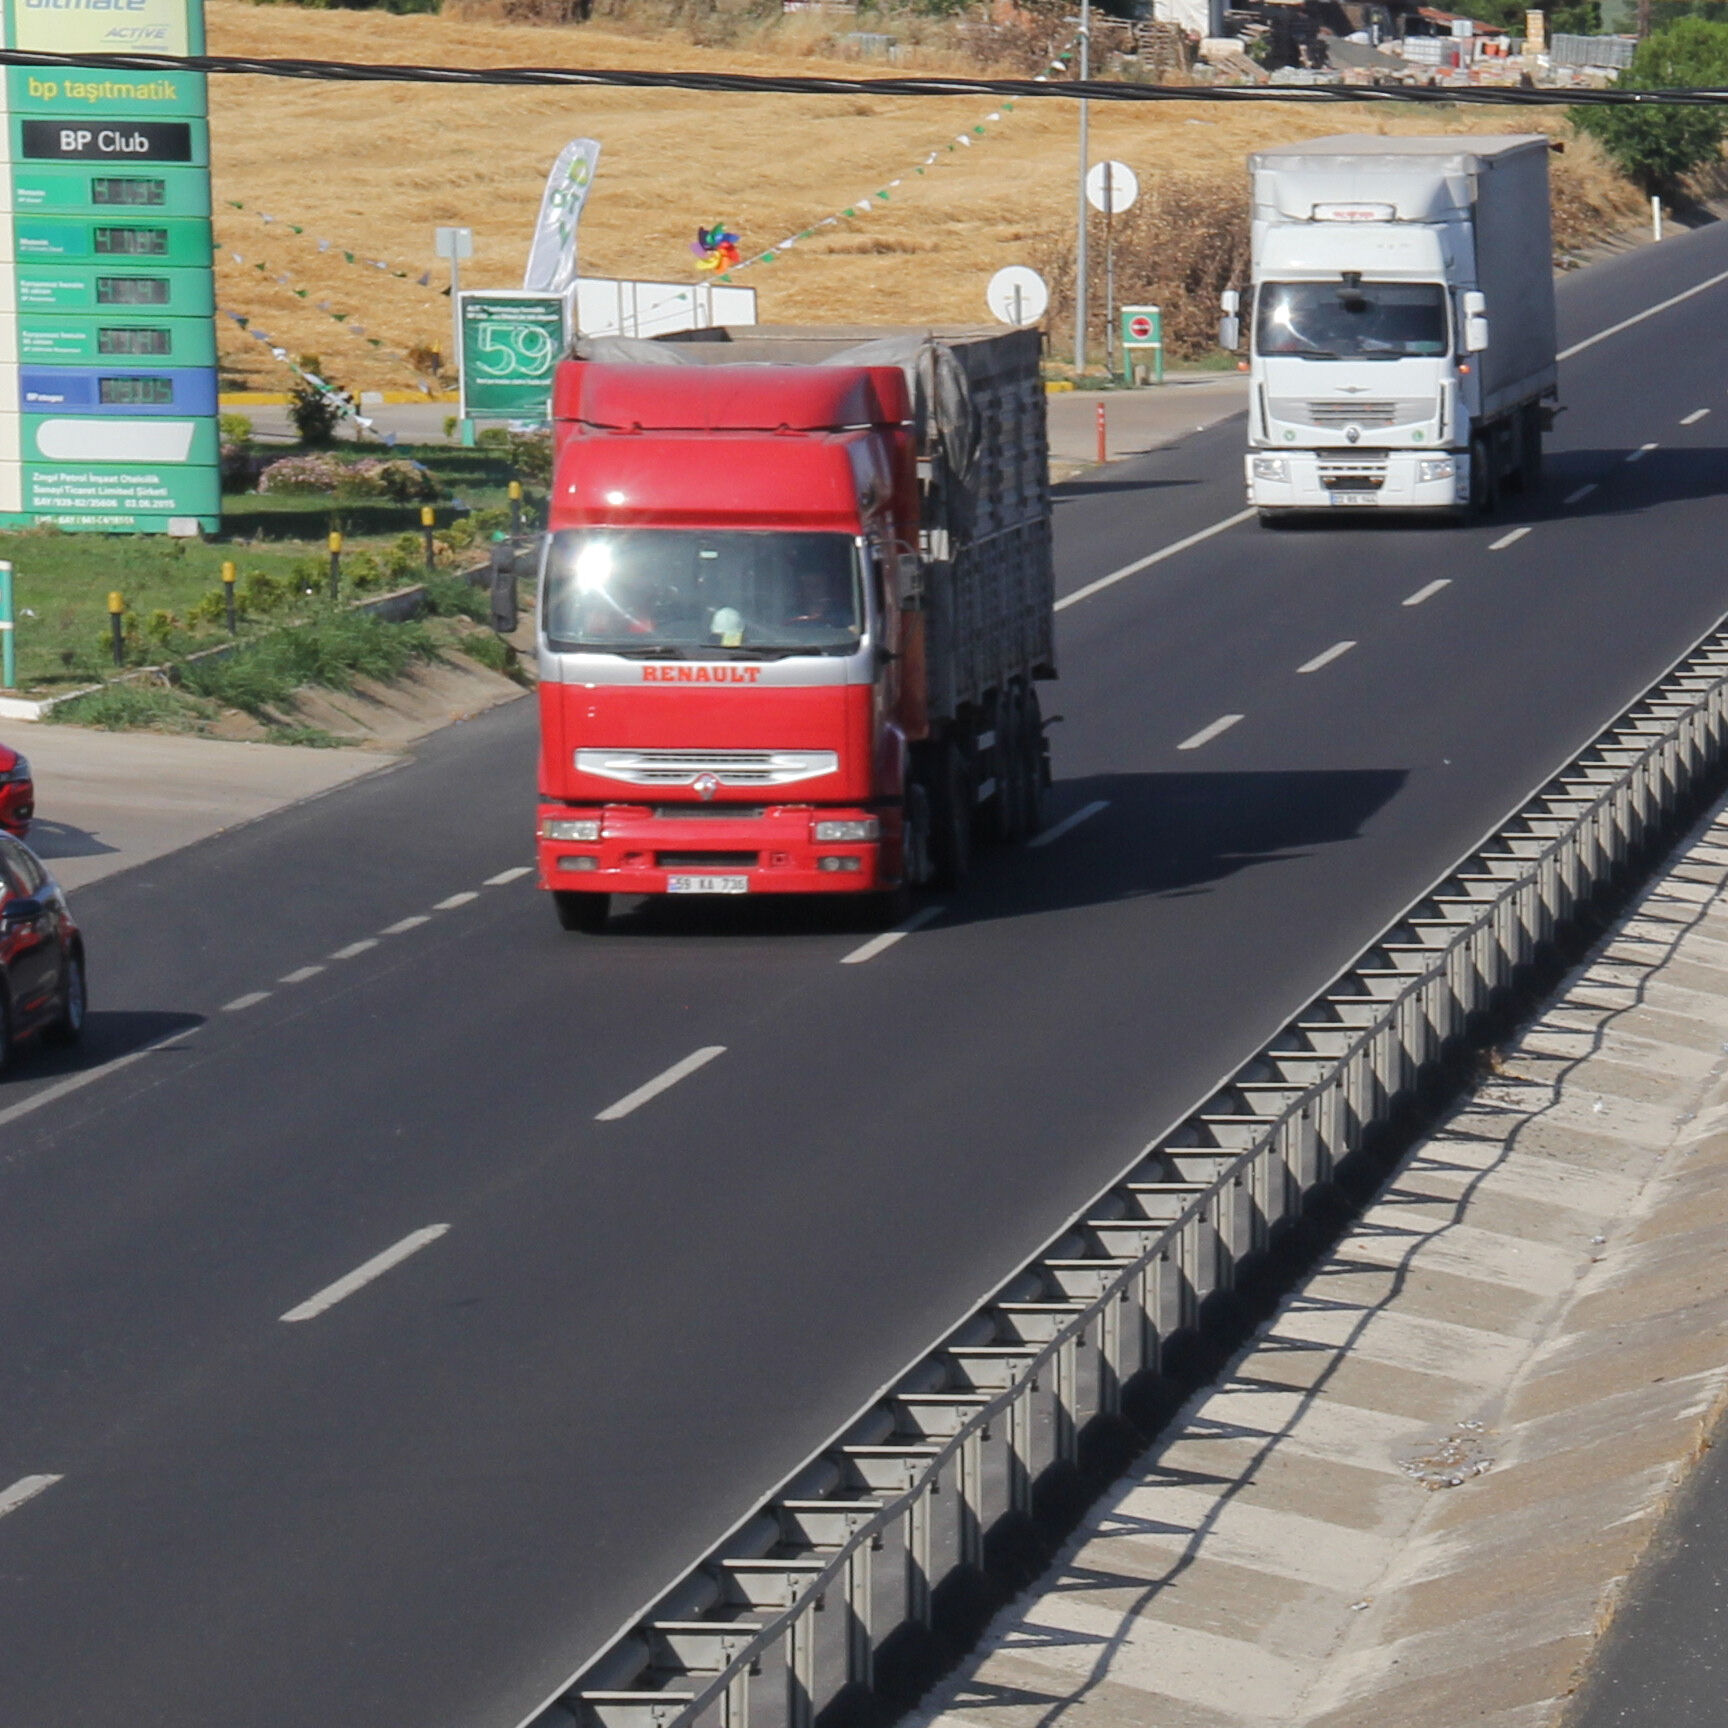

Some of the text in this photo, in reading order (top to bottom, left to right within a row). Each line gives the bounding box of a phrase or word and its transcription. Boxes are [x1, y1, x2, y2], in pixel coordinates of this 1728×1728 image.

[105, 27, 167, 39] ACTIVE
[28, 78, 177, 104] bp taşıtmatik
[60, 130, 149, 152] BP Club
[476, 322, 552, 376] 59
[642, 665, 761, 682] RENAULT
